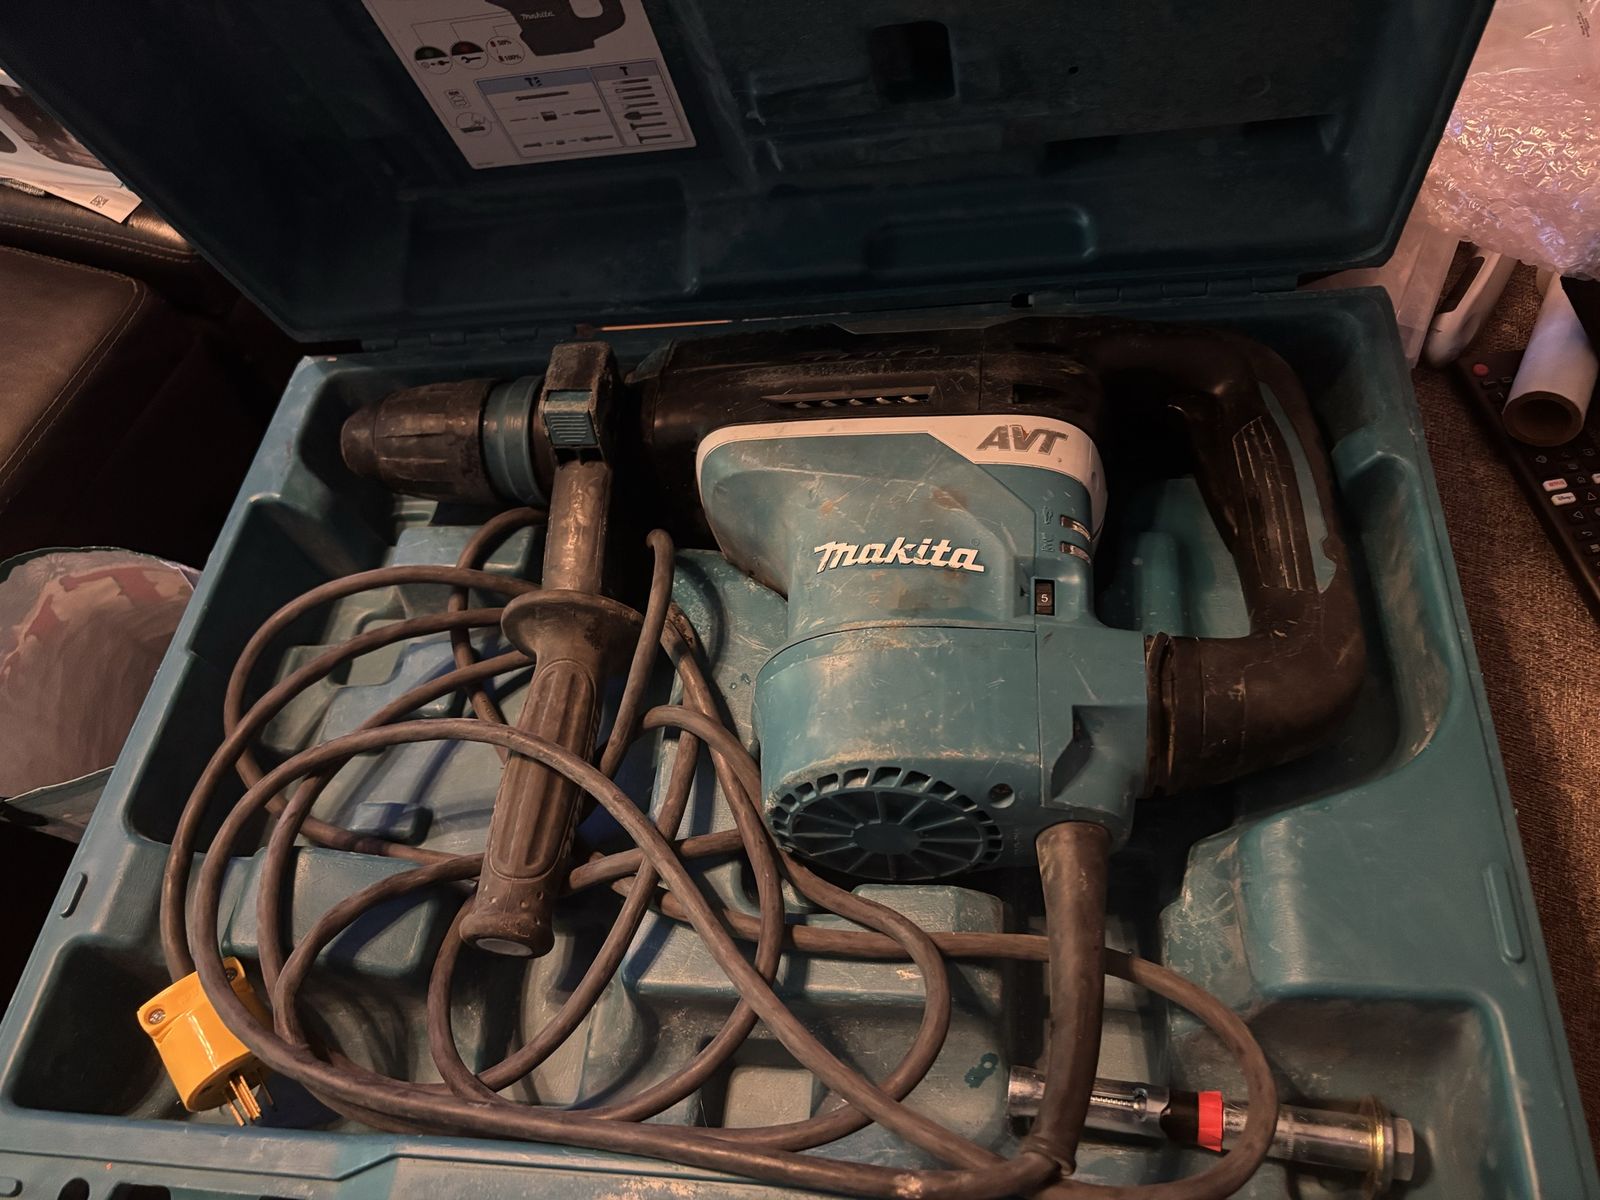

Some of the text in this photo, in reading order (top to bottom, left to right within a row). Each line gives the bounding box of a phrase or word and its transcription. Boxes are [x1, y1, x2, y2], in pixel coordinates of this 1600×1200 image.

[975, 424, 1069, 455] AVT
[813, 536, 985, 575] makita
[1040, 593, 1049, 603] 5
